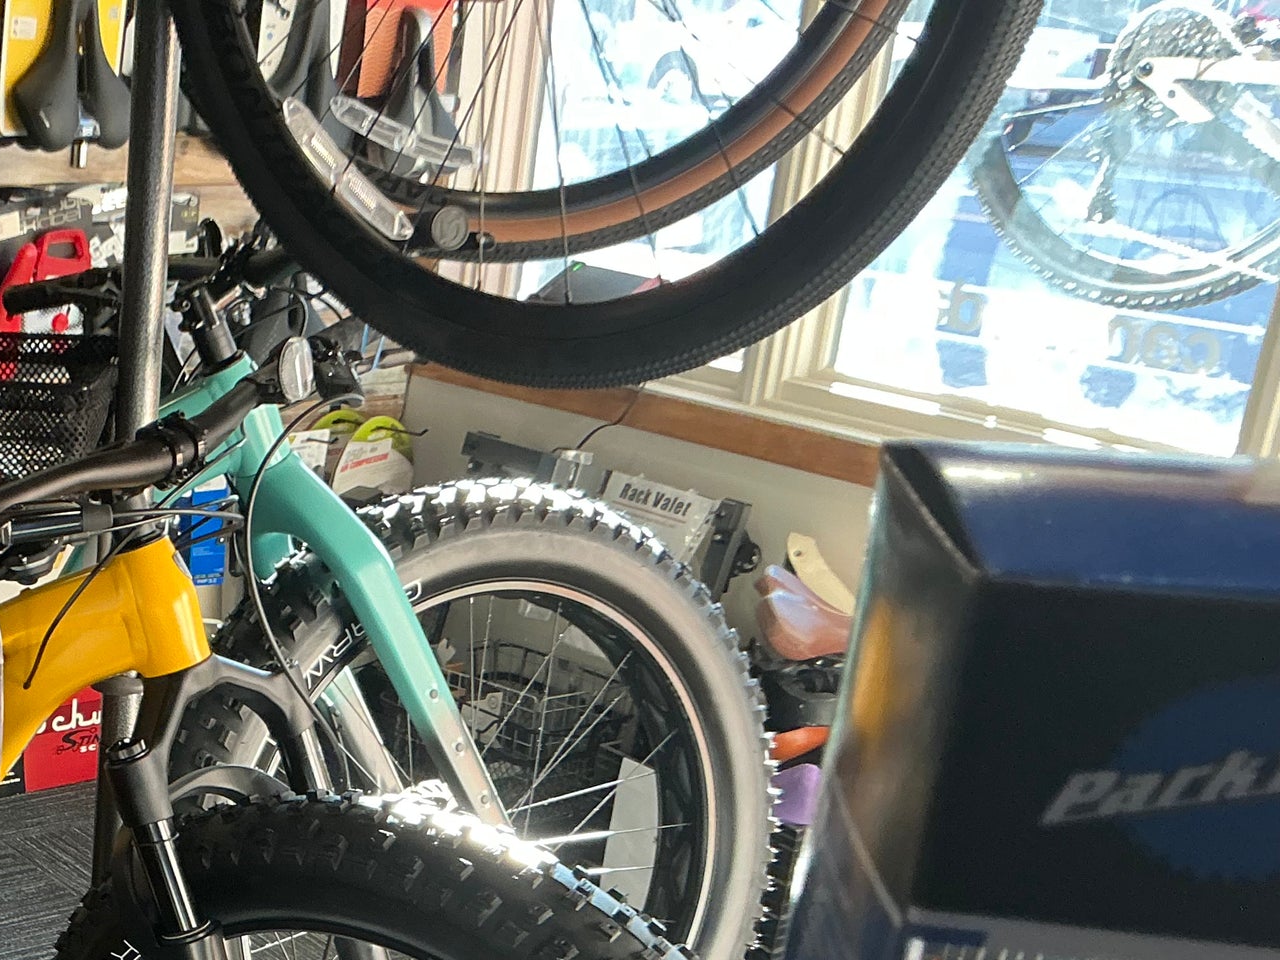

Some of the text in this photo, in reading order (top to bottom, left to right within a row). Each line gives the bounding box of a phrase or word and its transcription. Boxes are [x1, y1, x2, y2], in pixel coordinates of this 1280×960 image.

[618, 483, 692, 517] Rack Valet
[1040, 750, 1280, 828] Park
